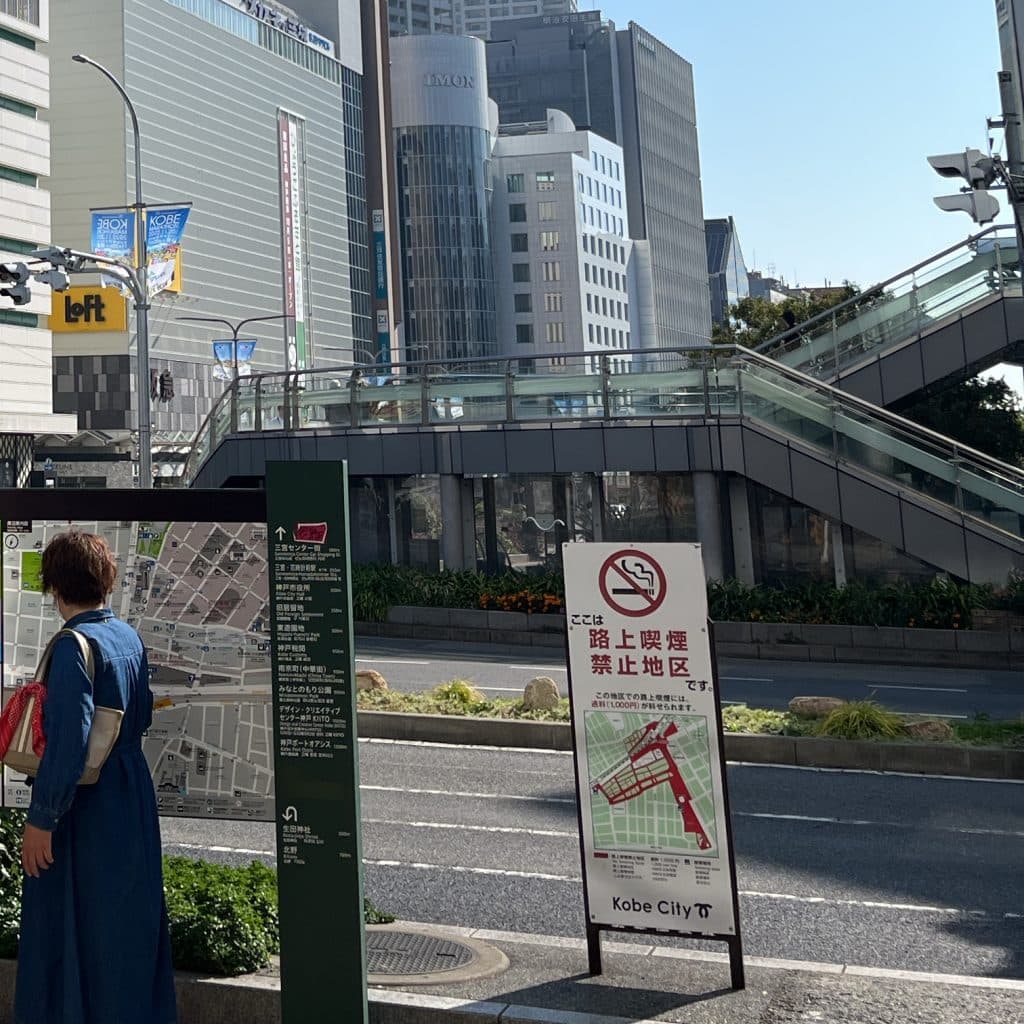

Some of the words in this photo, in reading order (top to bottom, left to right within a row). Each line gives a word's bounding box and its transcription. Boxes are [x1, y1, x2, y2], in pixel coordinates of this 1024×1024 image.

[150, 213, 182, 227] KOBE
[571, 614, 605, 626] ここは
[588, 628, 689, 652] 路上喫煙
[590, 654, 691, 678] 禁止地区
[685, 680, 713, 692] です。
[612, 896, 652, 913] Kobe
[657, 900, 692, 919] City
